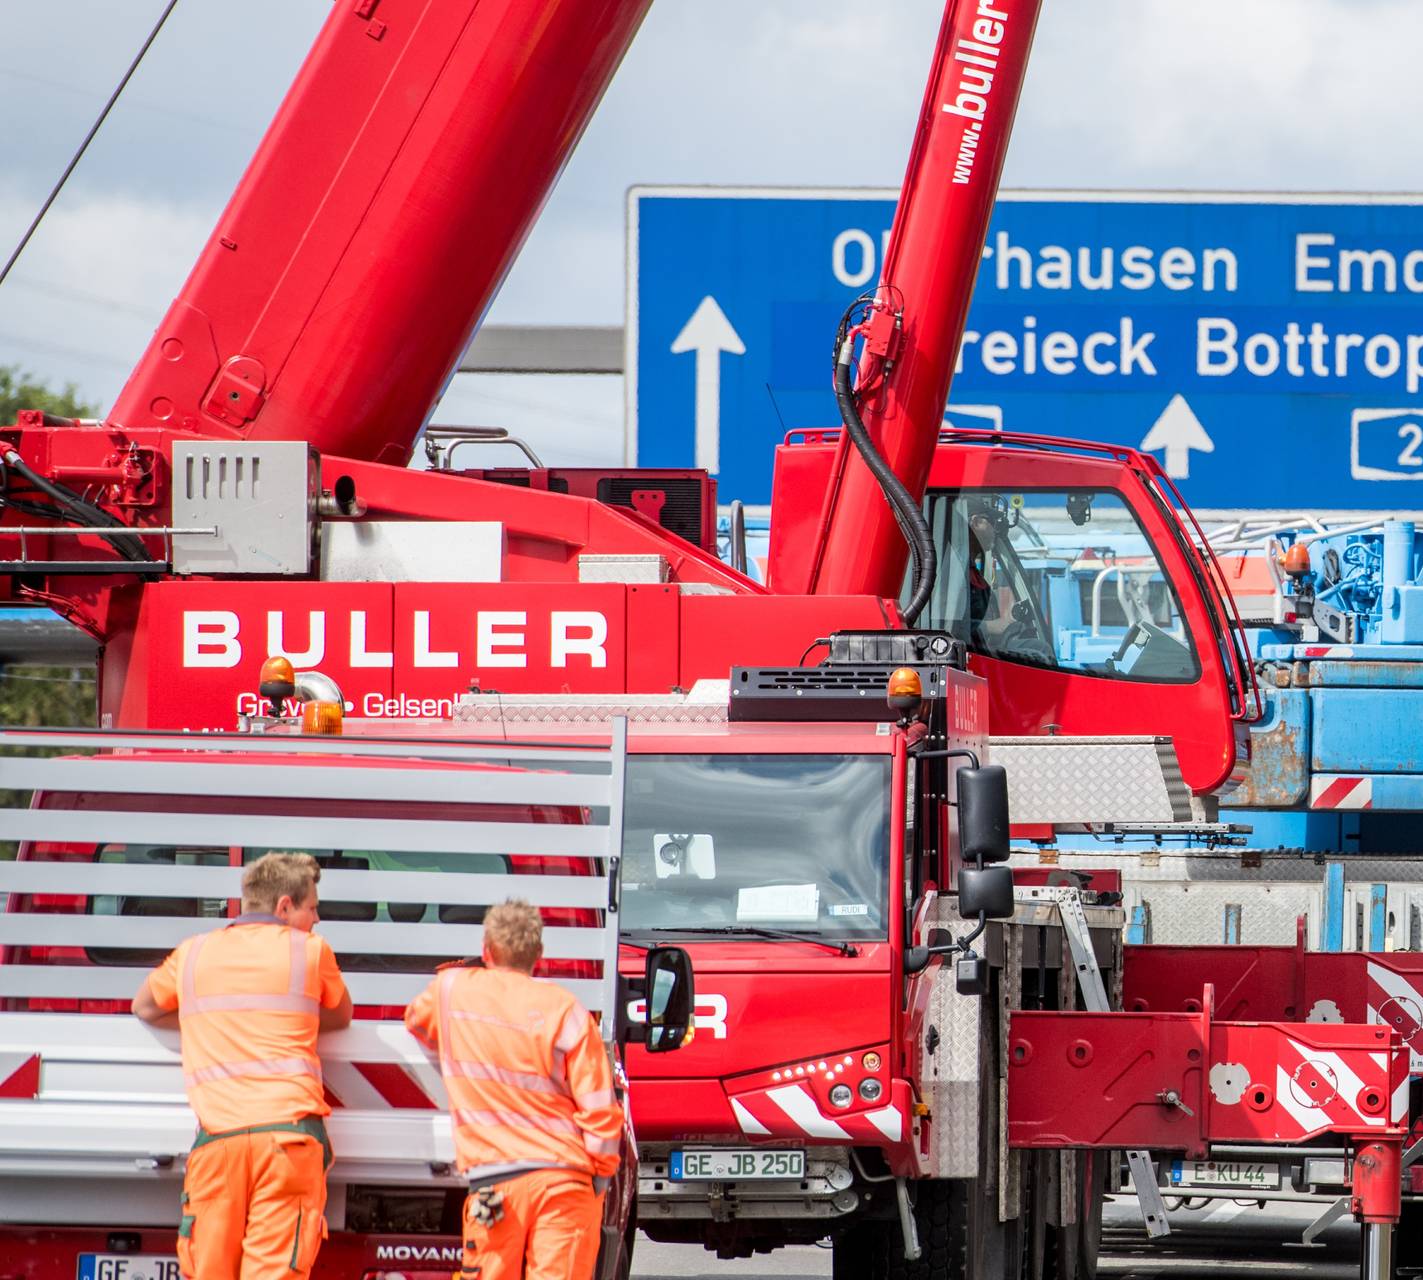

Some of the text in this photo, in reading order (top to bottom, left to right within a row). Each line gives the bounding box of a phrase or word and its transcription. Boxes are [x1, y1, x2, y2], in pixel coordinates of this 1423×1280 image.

[832, 229, 1238, 292] Ohausen
[954, 316, 1157, 376] reieck
[1398, 423, 1423, 466] 2
[183, 611, 607, 668] BULLER
[363, 692, 459, 717] Gelsen
[684, 1155, 712, 1175] GE
[727, 1154, 756, 1175] JB
[761, 1154, 802, 1175] 250
[1194, 1163, 1205, 1180] E
[1217, 1163, 1240, 1182] KU
[1244, 1165, 1265, 1182] 44
[99, 1260, 128, 1280] GE
